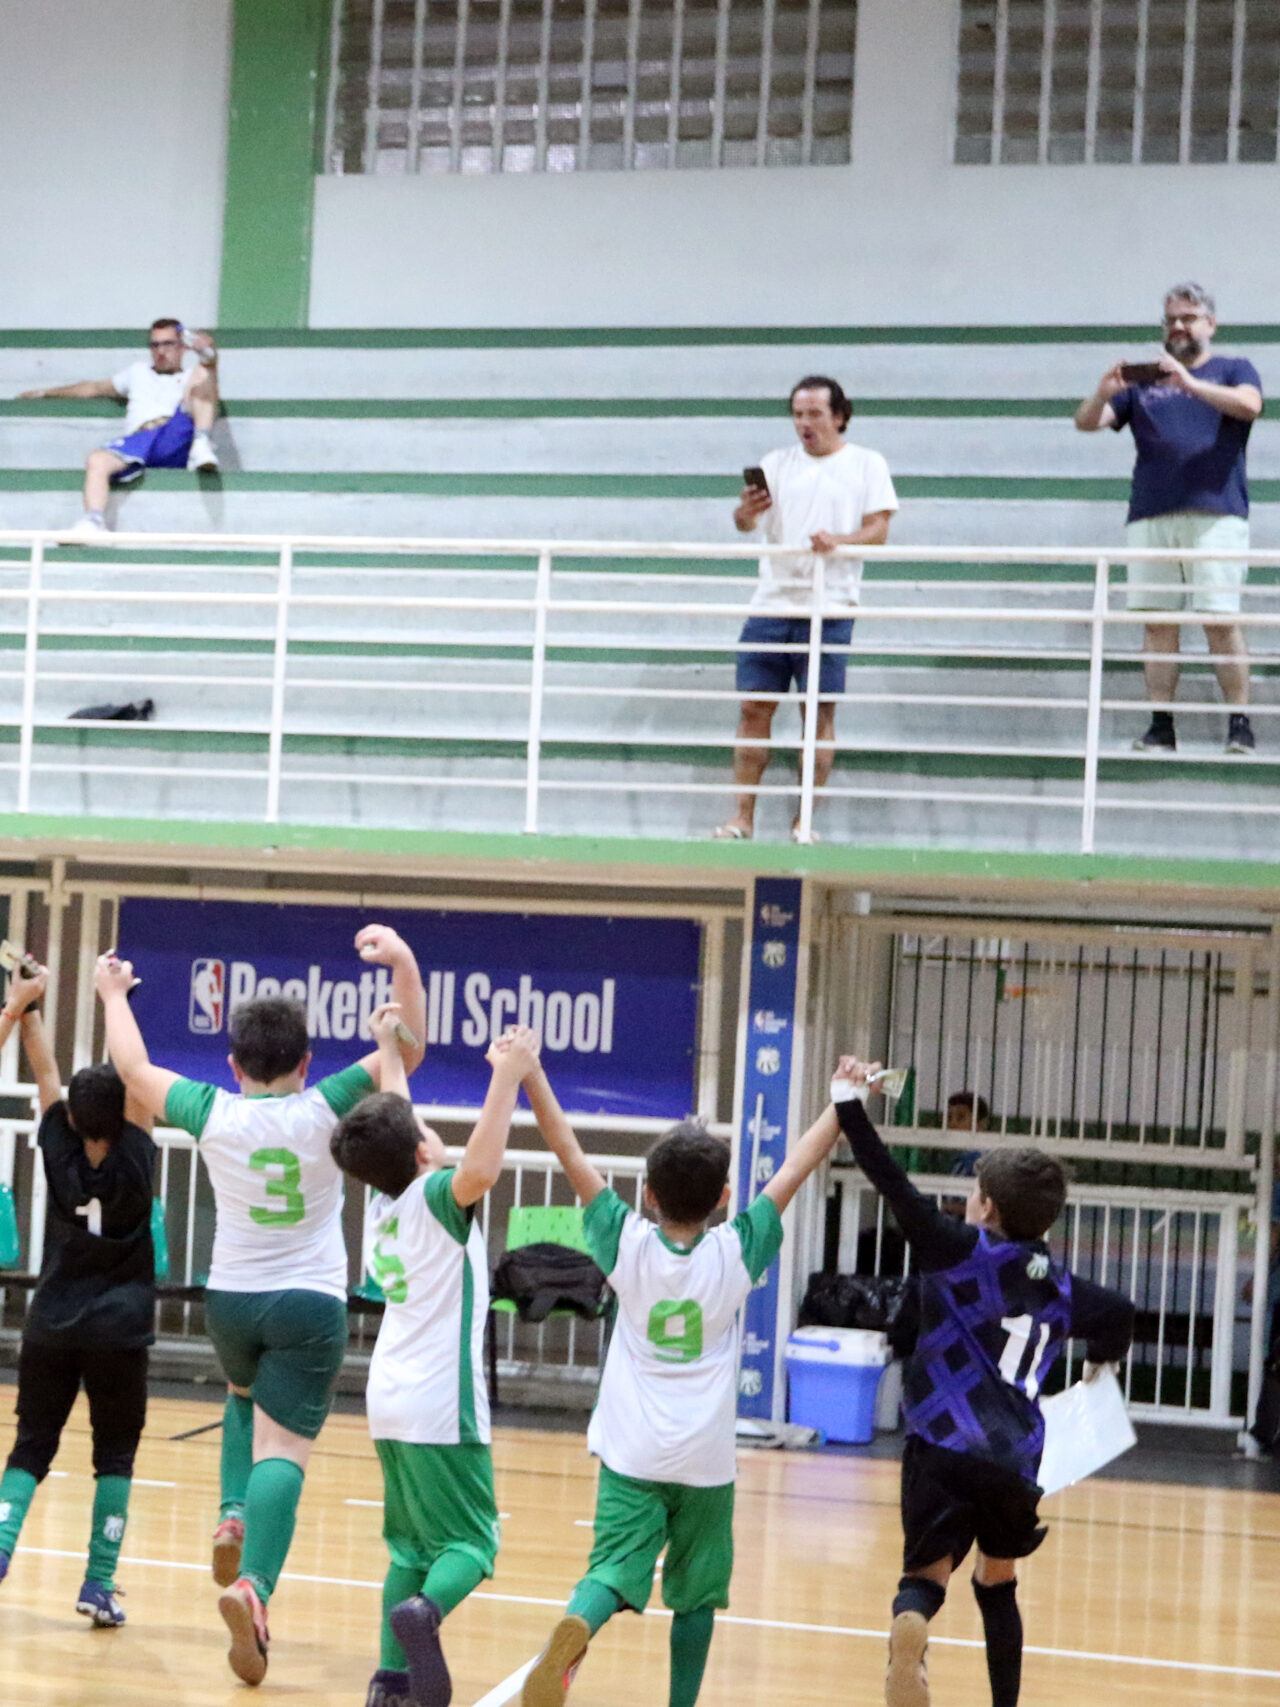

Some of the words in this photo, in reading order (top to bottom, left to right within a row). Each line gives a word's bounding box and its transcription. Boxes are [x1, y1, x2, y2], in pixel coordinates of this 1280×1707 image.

[75, 1197, 102, 1236] 1
[249, 1147, 306, 1228] 3
[647, 1299, 703, 1364] 9
